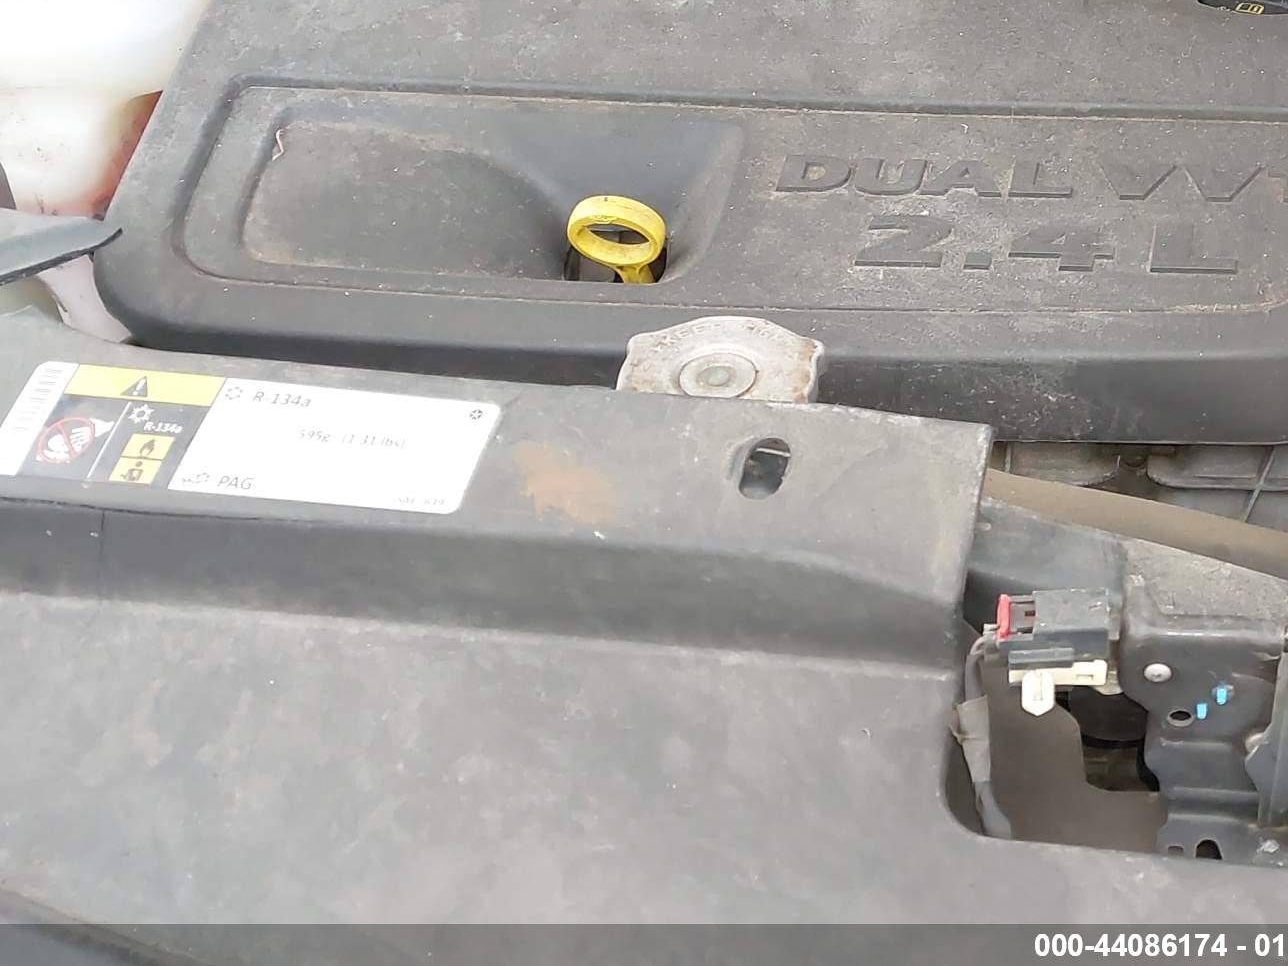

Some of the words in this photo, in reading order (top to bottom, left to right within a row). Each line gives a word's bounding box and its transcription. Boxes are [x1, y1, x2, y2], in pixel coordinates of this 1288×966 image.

[775, 153, 1074, 199] DUAL
[252, 391, 311, 408] R-134a
[217, 475, 255, 490] PAG
